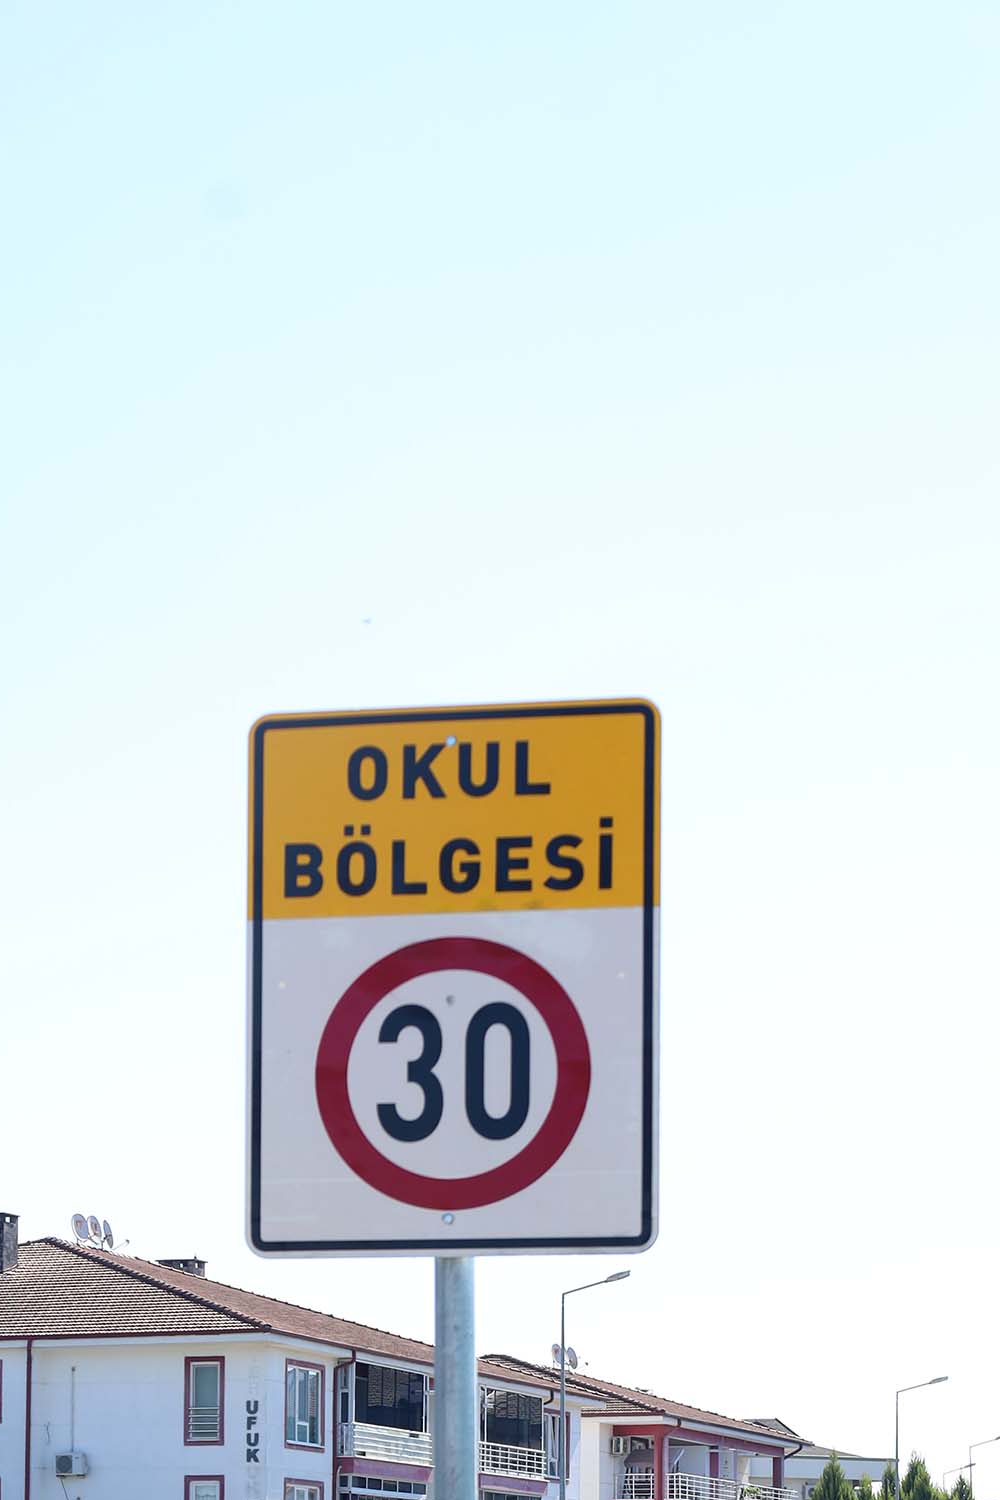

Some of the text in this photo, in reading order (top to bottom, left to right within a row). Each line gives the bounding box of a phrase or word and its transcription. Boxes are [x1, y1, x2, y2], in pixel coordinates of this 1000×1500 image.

[347, 740, 551, 800] OKUL
[283, 816, 614, 898] BÖLGESİ
[376, 1001, 532, 1143] 30
[246, 1400, 259, 1463] UFUK
